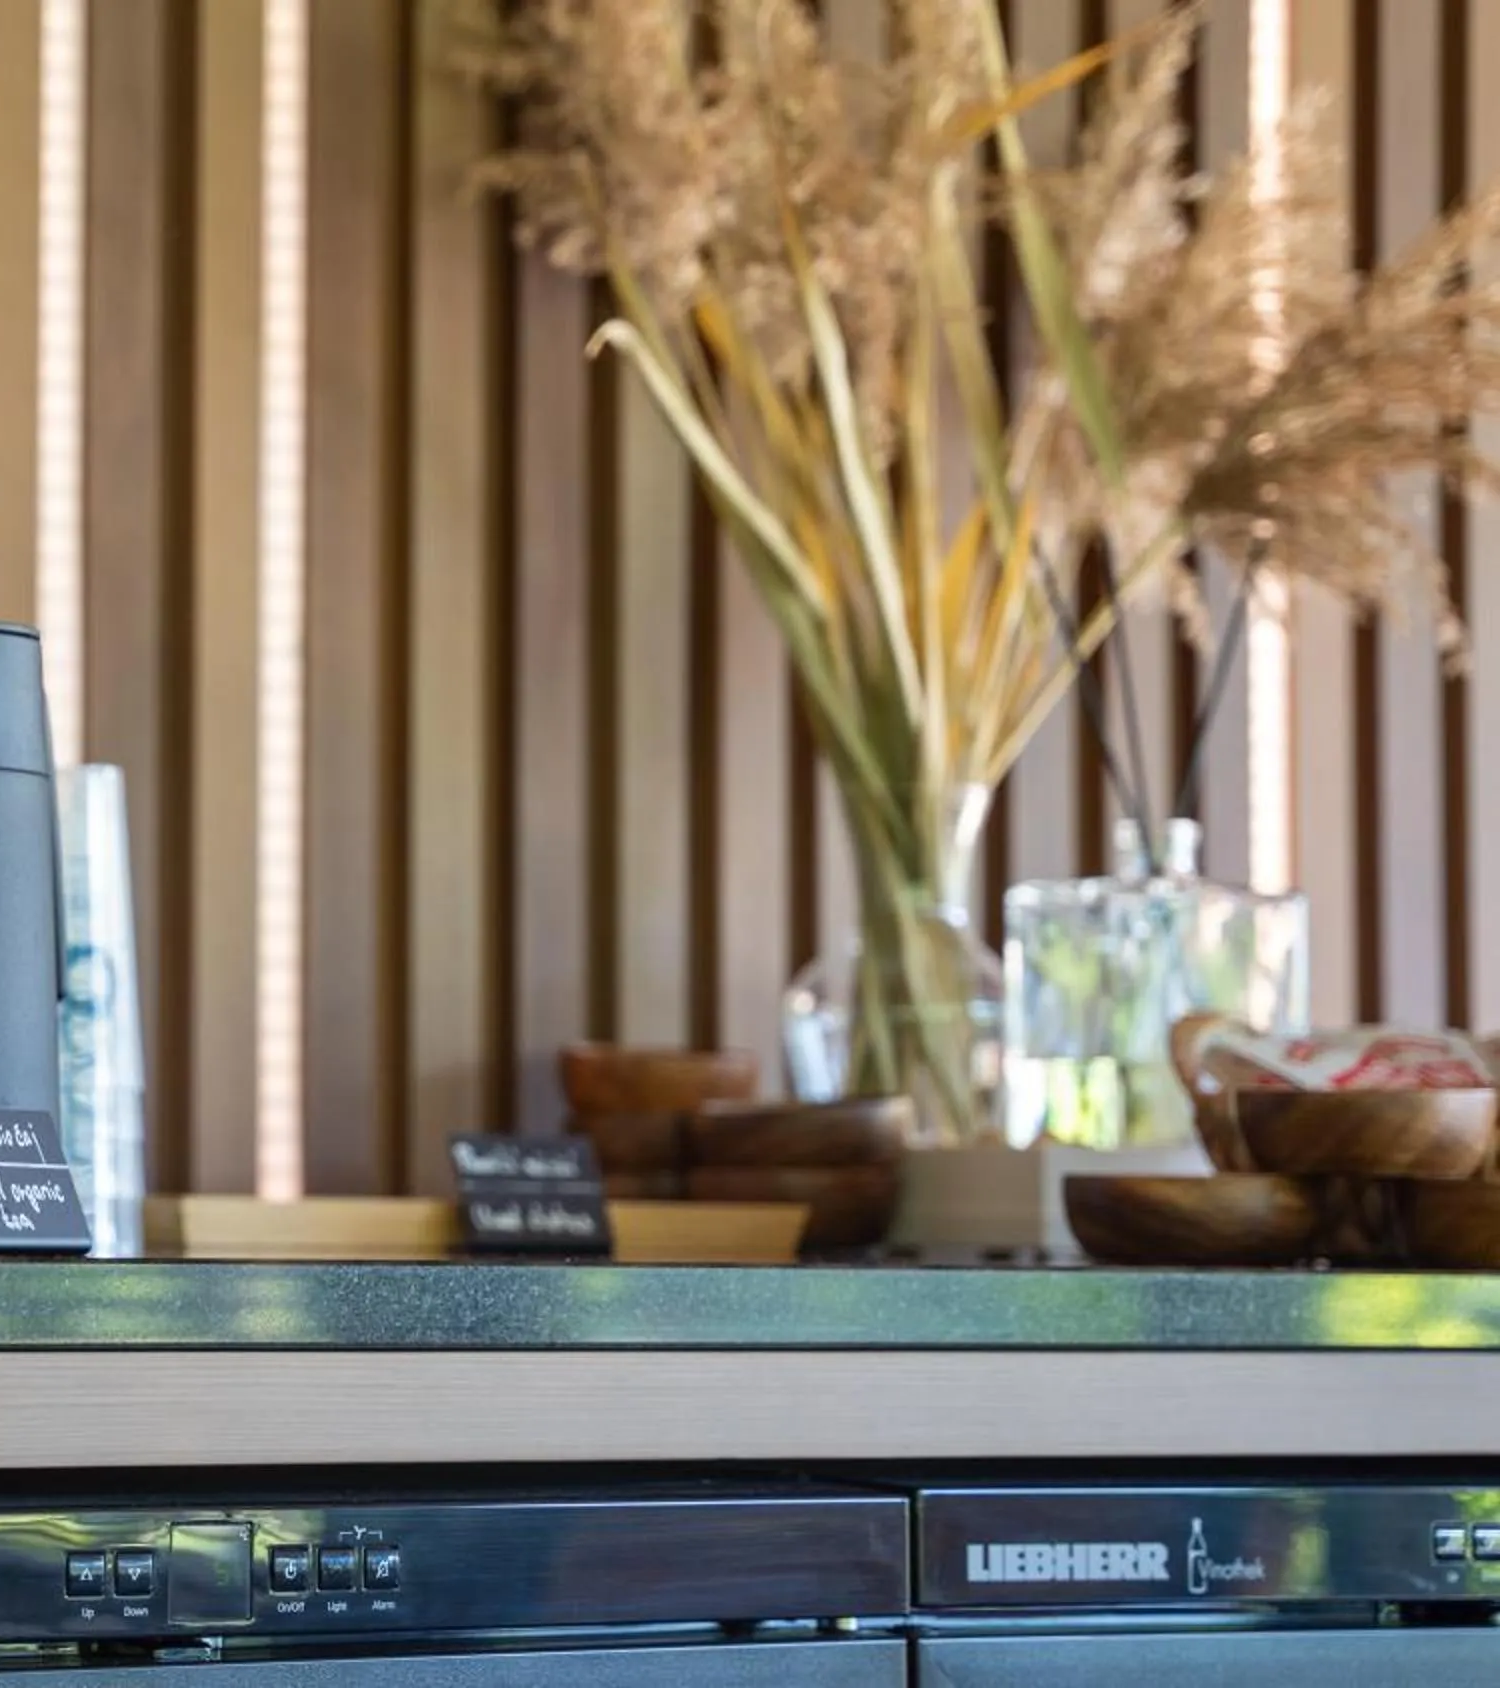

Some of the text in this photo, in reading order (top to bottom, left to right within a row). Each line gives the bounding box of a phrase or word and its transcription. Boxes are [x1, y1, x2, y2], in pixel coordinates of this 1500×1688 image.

[11, 1179, 65, 1213] organic
[0, 1203, 35, 1231] tea
[966, 1542, 1169, 1582] LIEBHERR
[123, 1606, 149, 1618] Down
[277, 1601, 306, 1613] On/Off
[327, 1601, 348, 1613] Light
[371, 1600, 396, 1611] Alarm
[81, 1606, 96, 1621] Up
